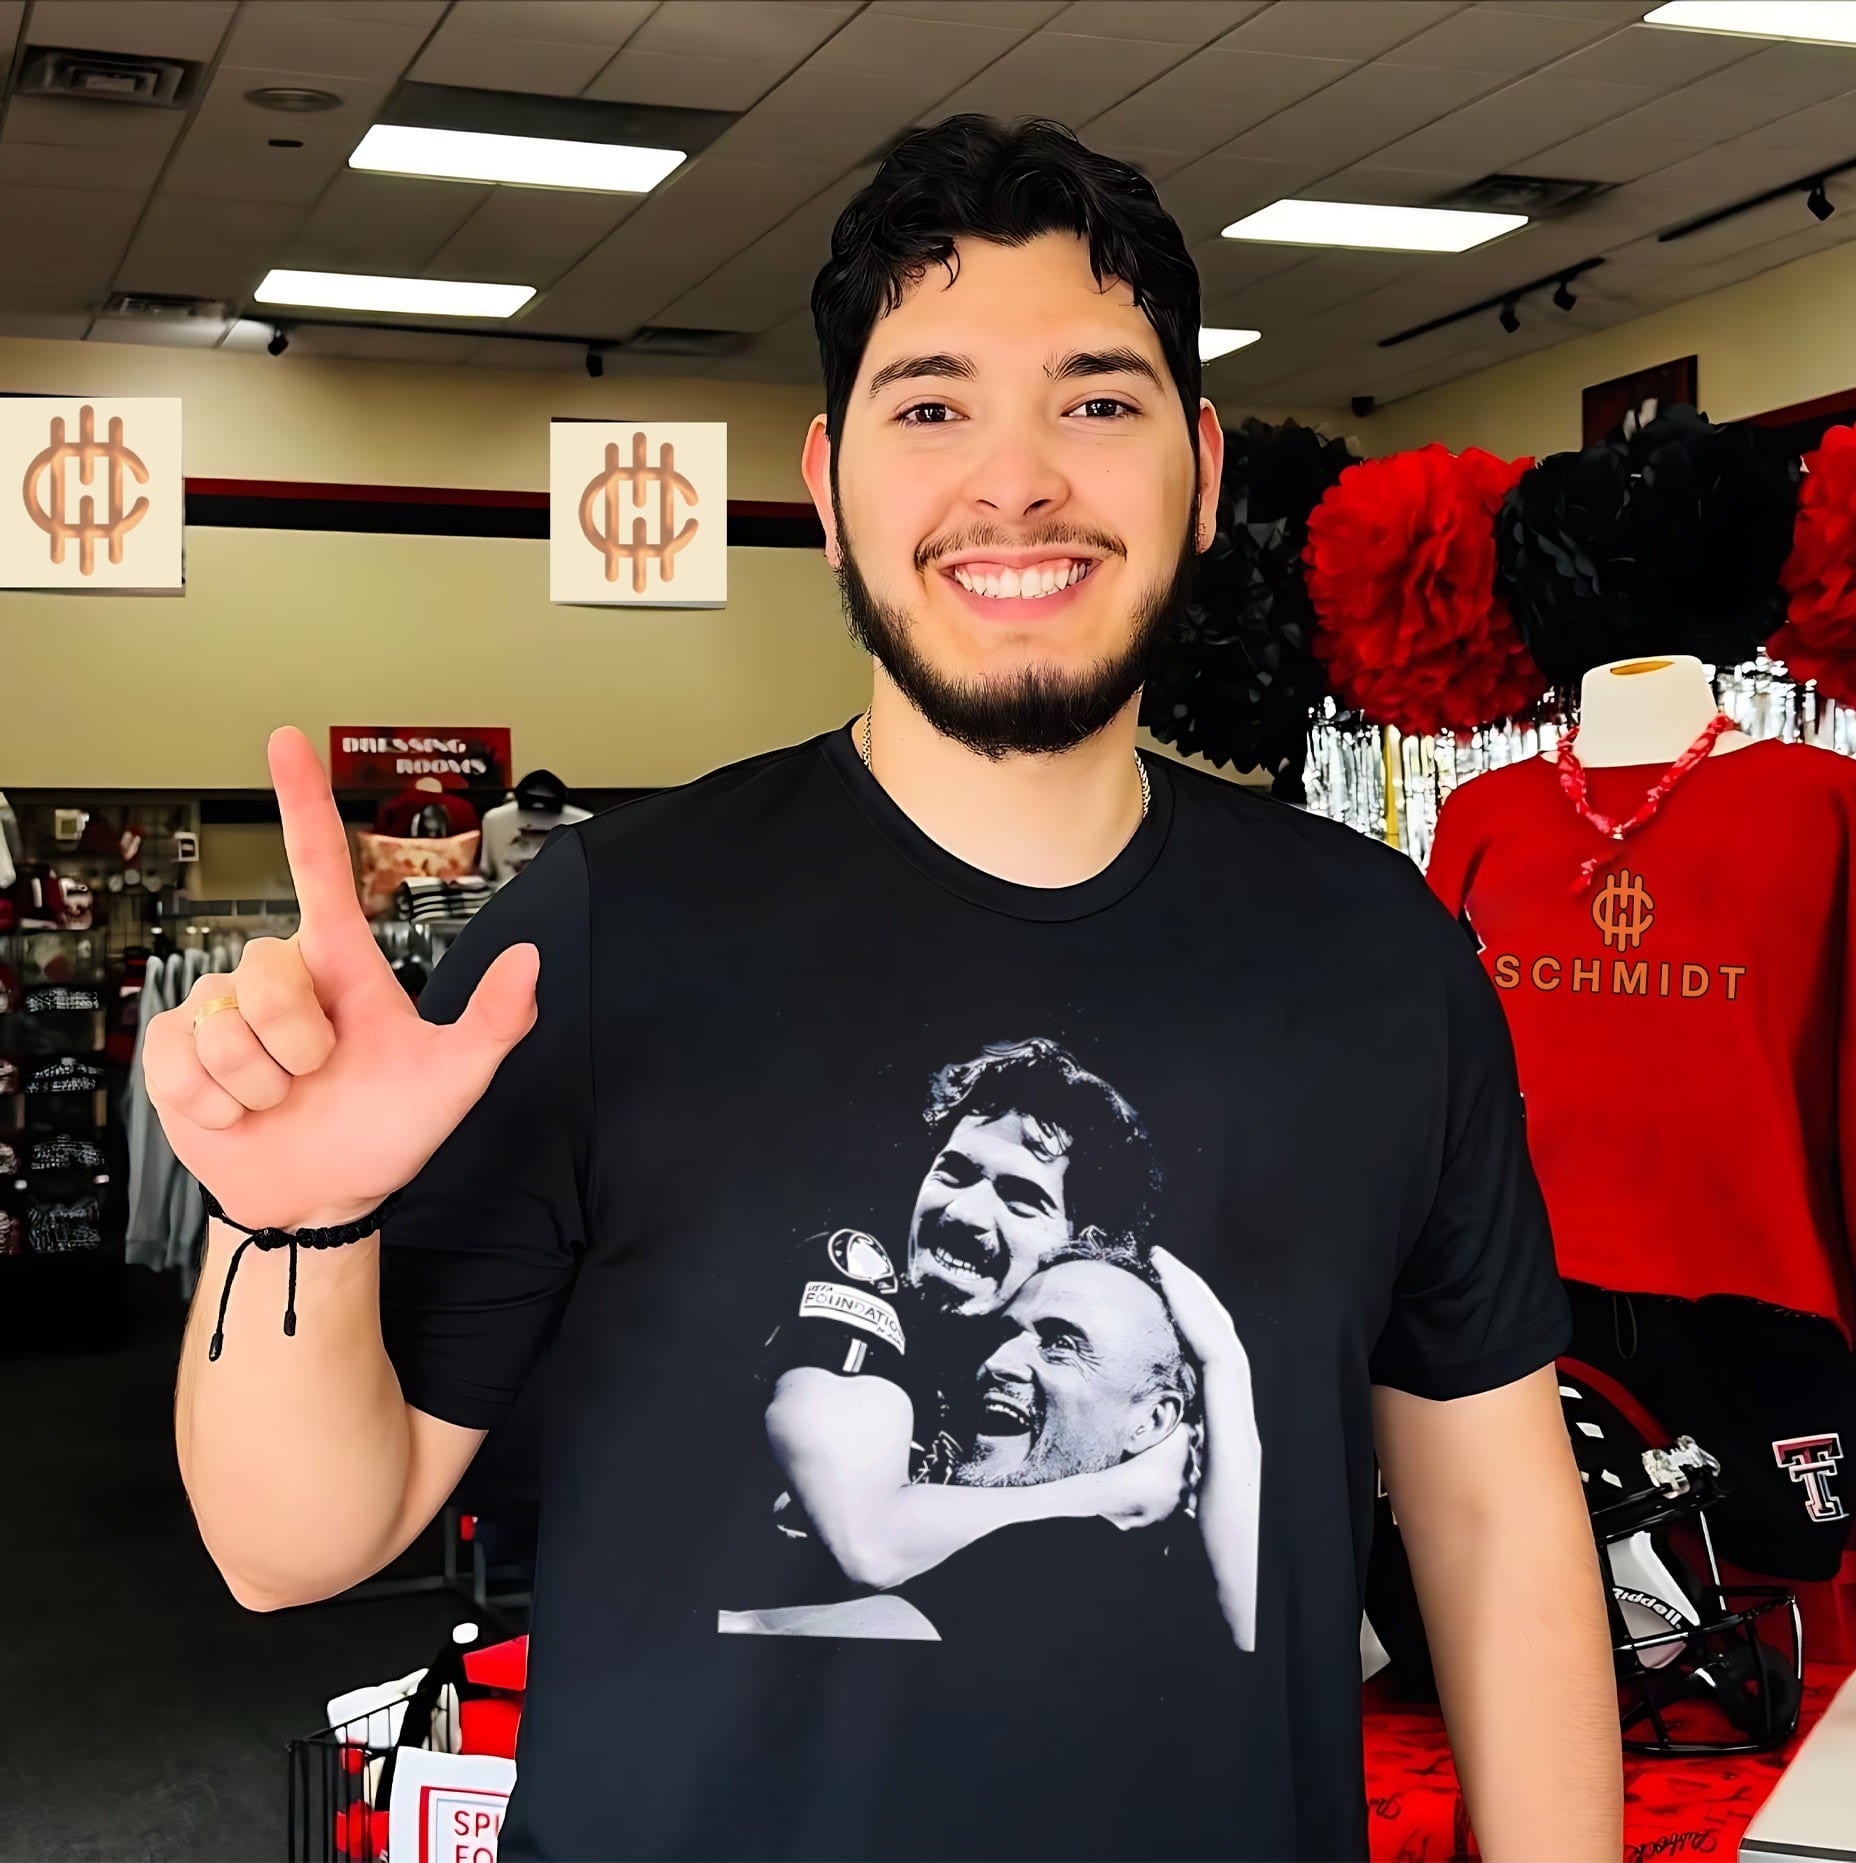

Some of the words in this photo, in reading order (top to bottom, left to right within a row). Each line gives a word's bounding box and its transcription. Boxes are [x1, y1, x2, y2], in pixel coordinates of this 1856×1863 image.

[342, 737, 467, 754] DRESSING
[396, 758, 487, 774] ROOMS
[1494, 954, 1746, 1000] SCHMIDT
